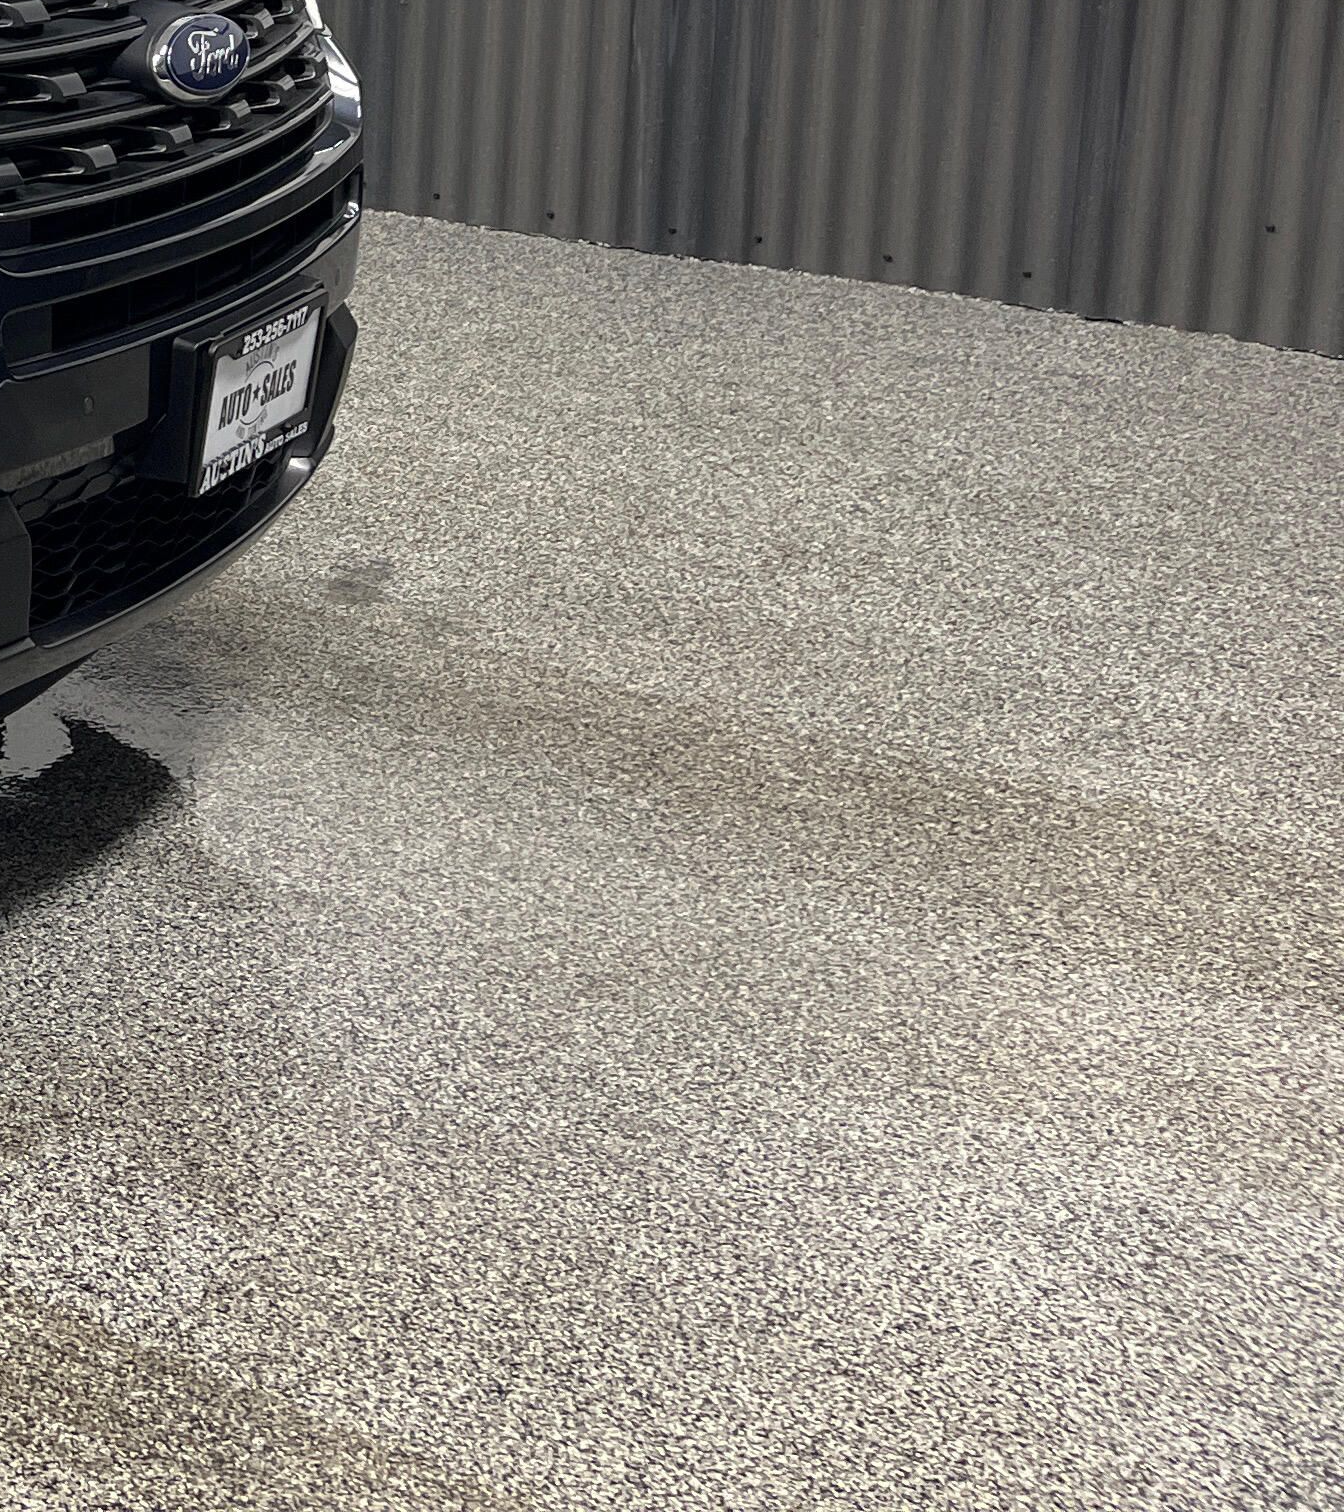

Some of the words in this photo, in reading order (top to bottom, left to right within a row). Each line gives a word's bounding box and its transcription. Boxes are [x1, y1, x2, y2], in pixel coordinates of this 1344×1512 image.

[187, 26, 240, 82] Ford
[218, 383, 253, 431] AUTO
[260, 359, 297, 407] SALES
